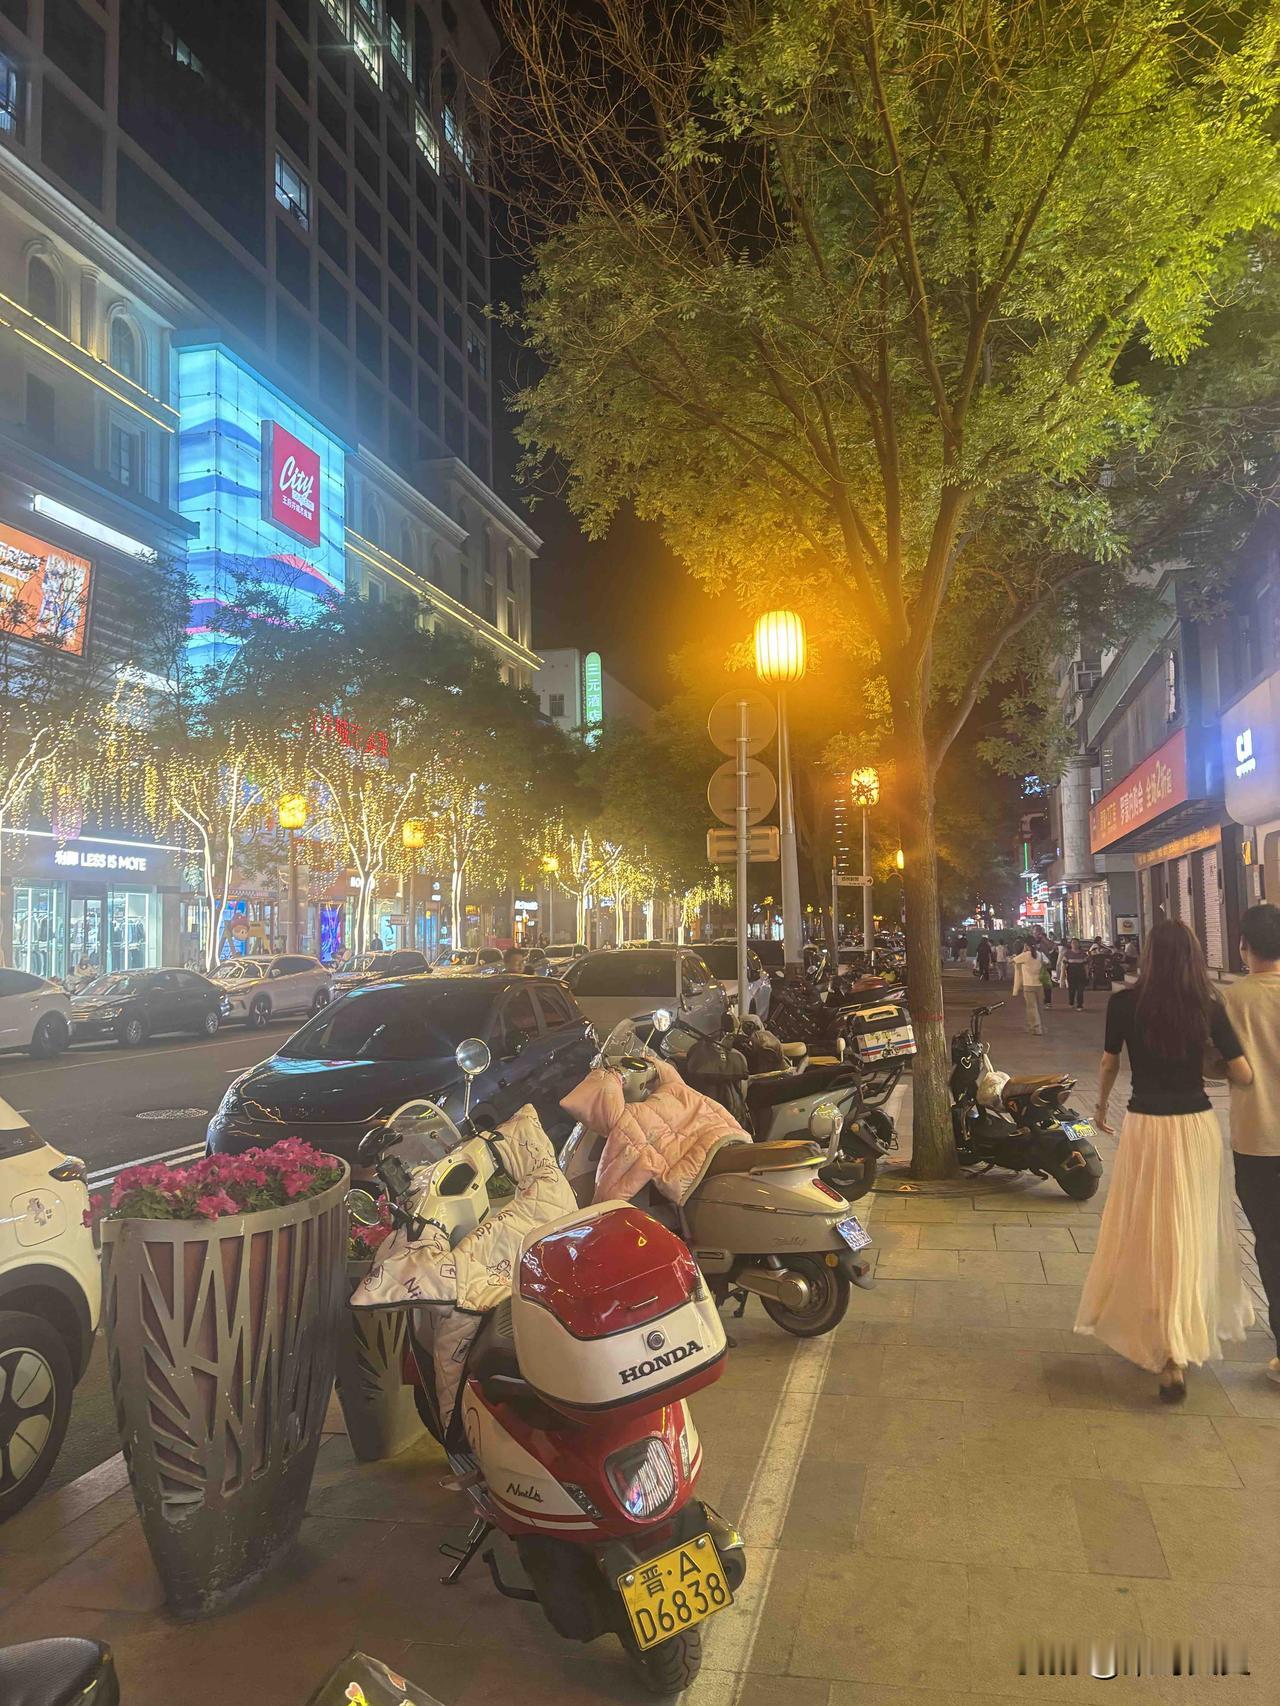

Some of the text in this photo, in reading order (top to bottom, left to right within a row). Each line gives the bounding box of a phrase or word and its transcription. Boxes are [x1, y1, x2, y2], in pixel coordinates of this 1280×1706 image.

[280, 456, 313, 504] City
[81, 852, 106, 868] LESS
[107, 854, 117, 869] IS
[619, 1340, 703, 1385] HONDA
[635, 1572, 726, 1645] D6838
